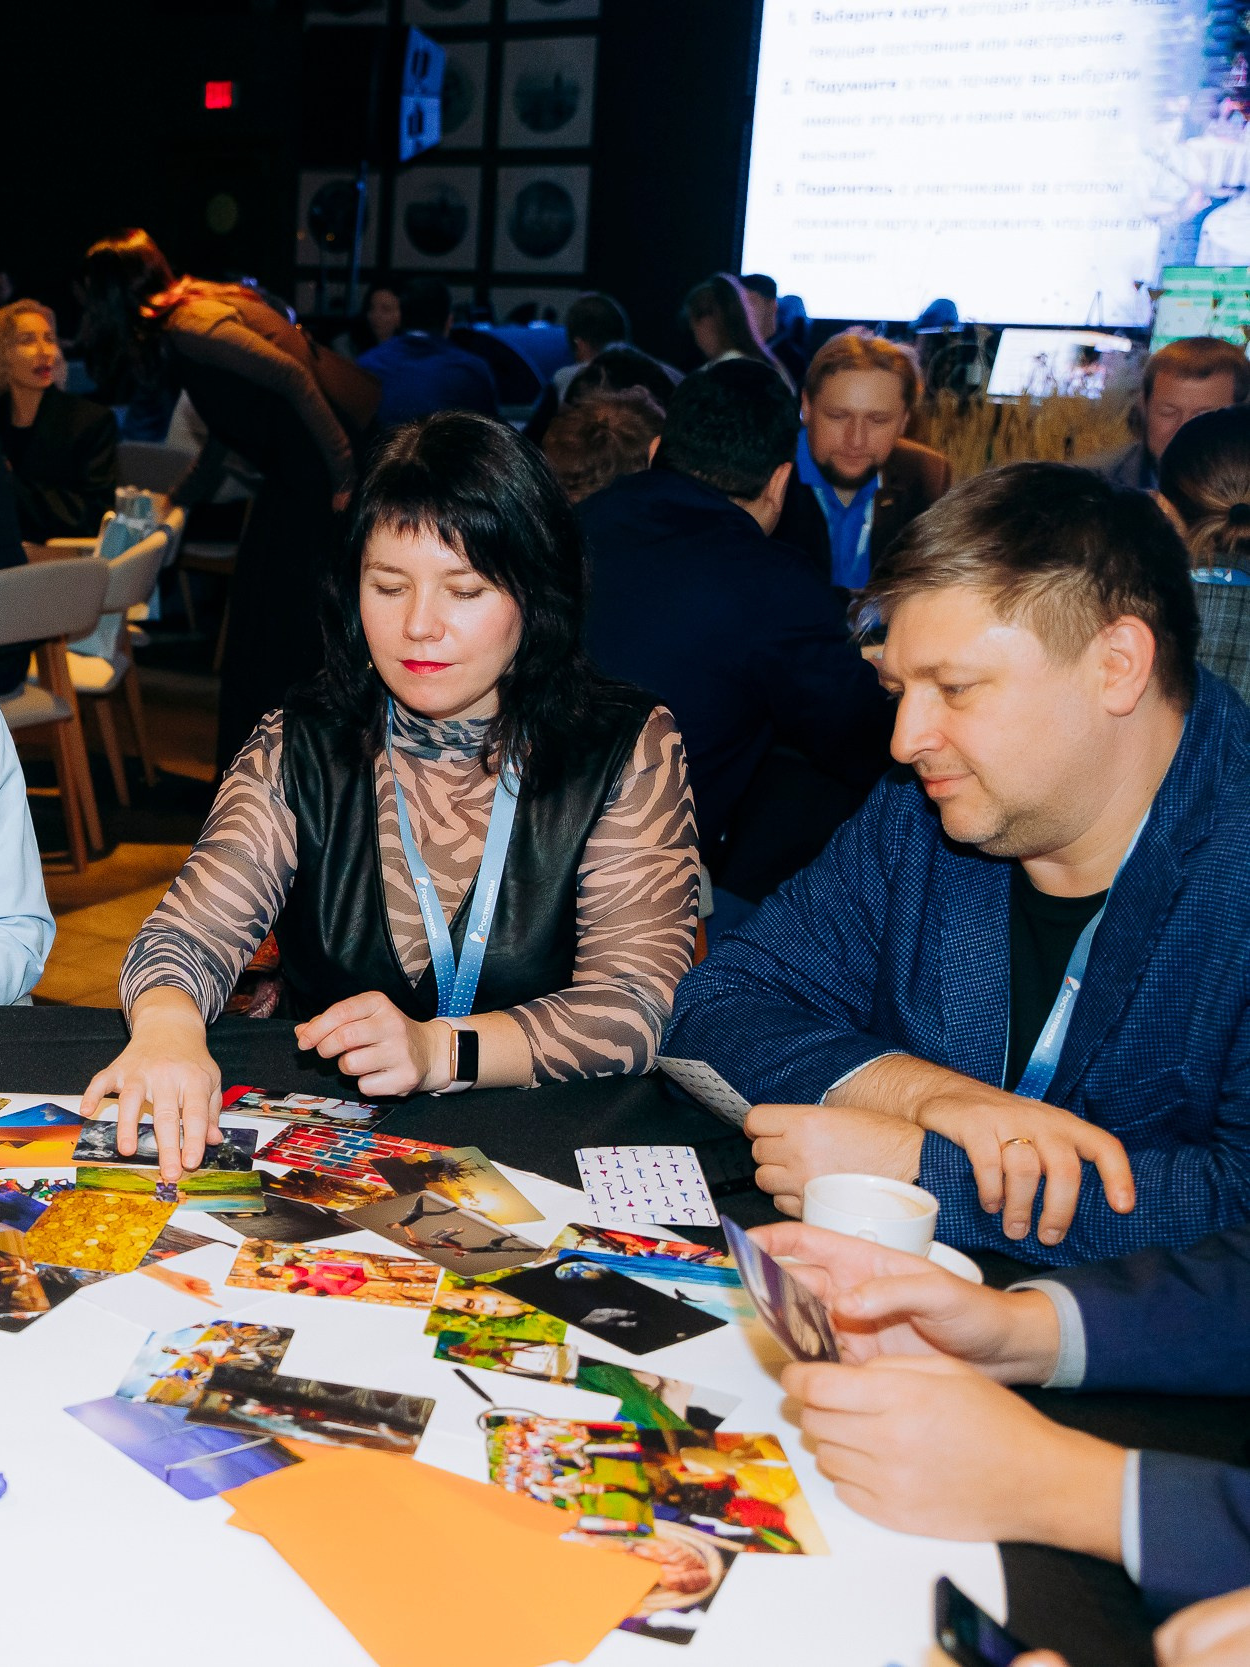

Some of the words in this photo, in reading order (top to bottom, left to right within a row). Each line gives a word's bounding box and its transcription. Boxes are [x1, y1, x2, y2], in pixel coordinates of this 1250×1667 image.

[419, 887, 438, 940] Ростелеком
[478, 879, 496, 932] Ростелеком
[1042, 989, 1073, 1048] Ростелеком
